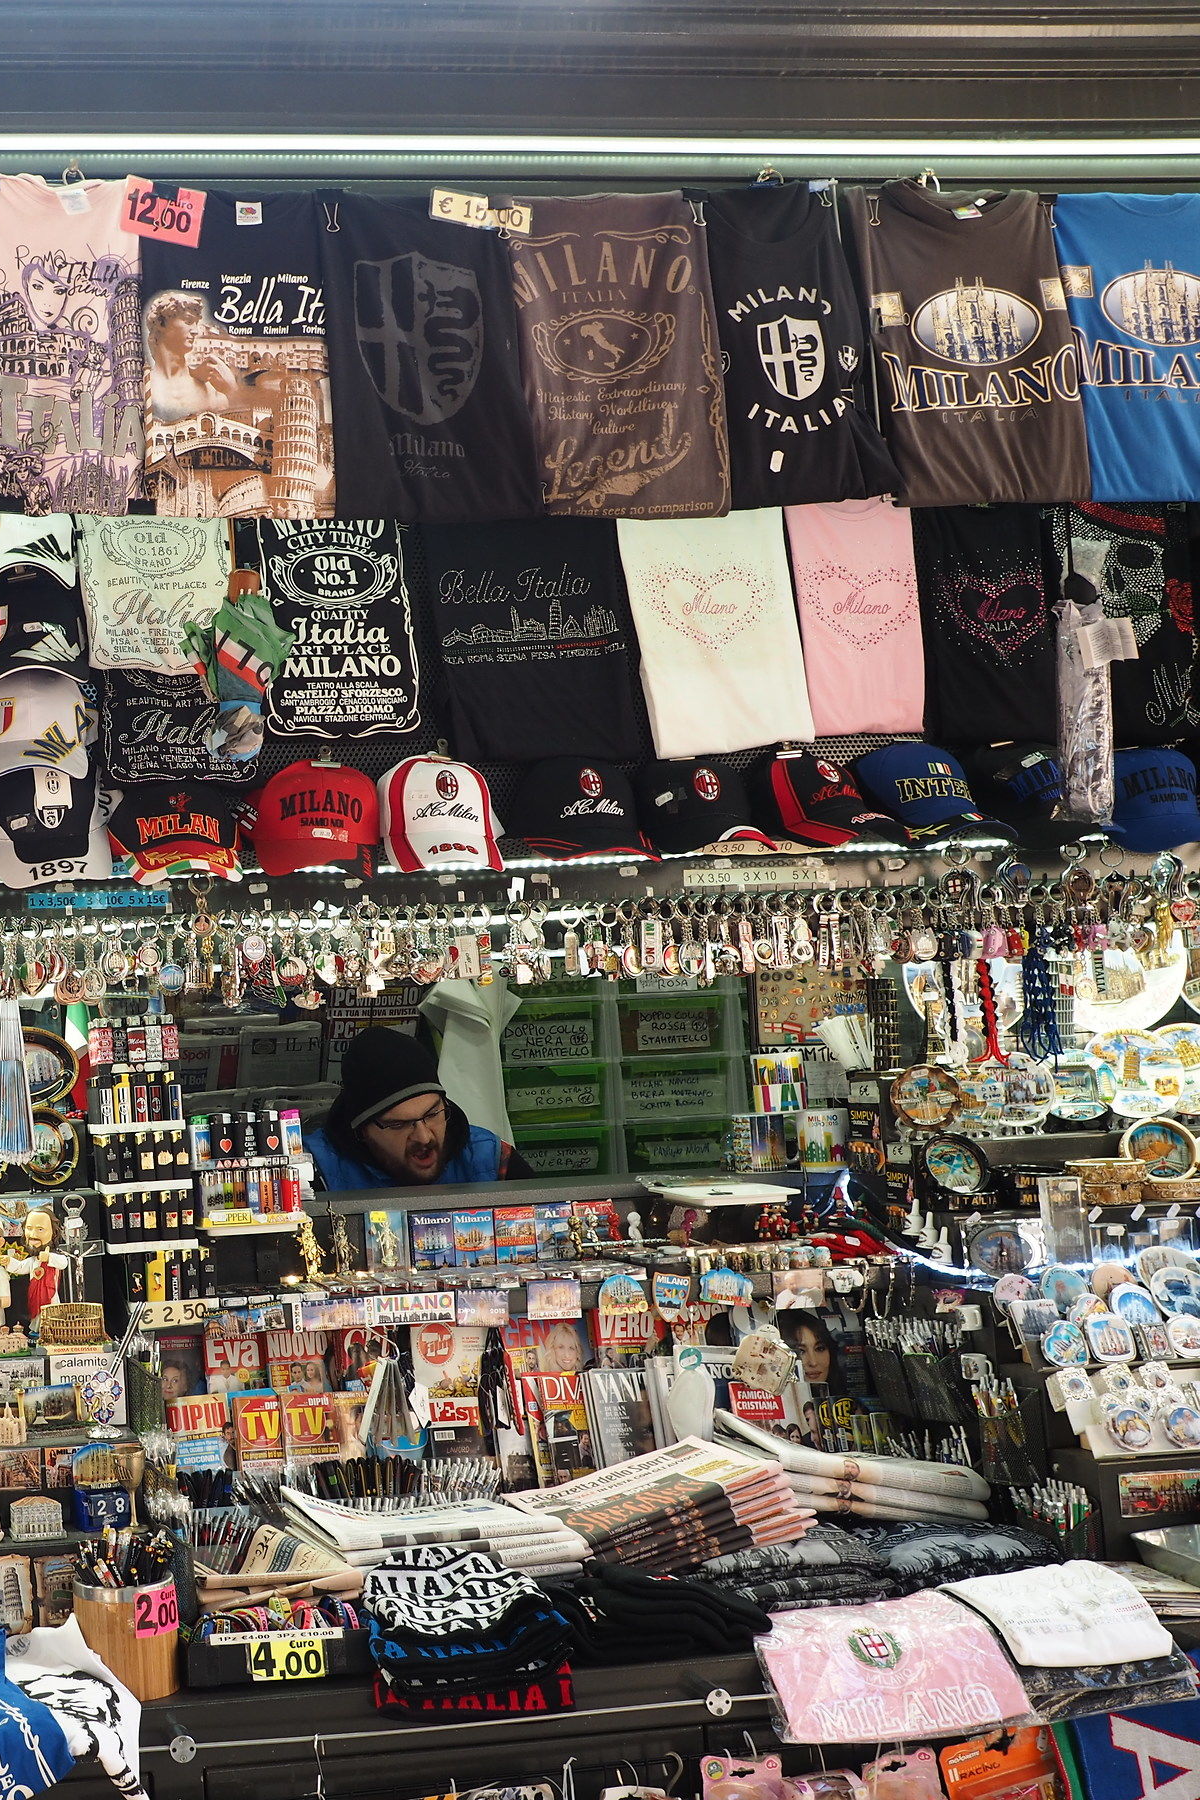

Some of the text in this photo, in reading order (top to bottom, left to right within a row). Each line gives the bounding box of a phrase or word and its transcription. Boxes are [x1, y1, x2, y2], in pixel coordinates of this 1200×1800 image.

[221, 274, 252, 285] Venezia
[278, 273, 308, 284] Milano
[513, 242, 692, 309] MILANO
[181, 279, 210, 291] Firenze
[216, 279, 284, 324] Bella
[228, 325, 252, 335] Roma
[263, 325, 289, 335] Rimini
[302, 325, 326, 335] Torino
[882, 345, 1081, 412] MILANO
[537, 380, 686, 406] Majestic Extraordinary
[549, 401, 678, 423] History Worldliness
[593, 422, 636, 437] Culture
[544, 406, 691, 504] Legend
[648, 500, 713, 514] comparison
[133, 532, 168, 545] Old
[286, 531, 372, 549] CITY TIME
[134, 556, 172, 568] BRAND
[313, 556, 351, 571] Old
[313, 571, 359, 585] No.1
[439, 563, 591, 604] Bella Italia
[154, 581, 207, 589] ART PLACES
[318, 588, 356, 597] BRAND
[682, 594, 738, 617] Milano
[833, 591, 893, 617] Milano
[311, 610, 369, 620] QUALITY
[106, 628, 138, 636] MILANO
[291, 617, 389, 644] Italia
[142, 638, 175, 647] VENEZIA
[113, 645, 140, 653] SIENA
[332, 644, 391, 655] PLACE
[496, 648, 601, 663] SIENA PISA FIRENZE
[283, 657, 401, 678] MILANO
[156, 676, 193, 685] BRAND
[307, 681, 334, 689] TEATRO
[336, 681, 354, 689] ALLA
[283, 688, 403, 699] CASTELLO SFORZESCO
[126, 698, 191, 707] BEAUTIFUL ART
[280, 696, 408, 706] SANT'AMBROGIO CENACOLO VINCIANO
[296, 704, 393, 715] PIAZZA DUOMO
[294, 713, 397, 722] NAVIGLI STAZIONE CENTRALE
[122, 747, 161, 755] MILANO
[128, 754, 197, 763] PISA VENEZIA
[131, 762, 238, 771] SIENA GARDA
[280, 791, 363, 824] MILANO
[300, 818, 323, 827] SIAMO
[138, 814, 219, 844] MILAN
[28, 860, 88, 881] 1897
[335, 991, 352, 1006] PC
[505, 1025, 585, 1036] DOPPIO COLLO
[651, 1021, 688, 1031] ROSSA
[526, 1036, 562, 1046] NERA
[641, 1033, 708, 1044] STAMPATELLO
[512, 1046, 589, 1059] STAMPATELLO
[536, 1095, 573, 1106] ROSA
[808, 1114, 838, 1122] MILANO
[886, 1171, 908, 1184] SIMPLY
[414, 1216, 450, 1225] Milano
[455, 1215, 490, 1223] Milano
[657, 1276, 689, 1286] MILANO
[376, 1294, 453, 1313] MILANO
[141, 1304, 206, 1325] € 2,50
[600, 1314, 654, 1339] VERO
[266, 1331, 328, 1358] NUOVO
[205, 1338, 260, 1367] Eva
[60, 1357, 107, 1367] calamite
[308, 1395, 329, 1406] DIPIÙ
[736, 1400, 779, 1411] CRISTIANA
[166, 1398, 226, 1432] DIPIÙ
[286, 1407, 323, 1435] TV
[241, 1410, 279, 1440] TV
[184, 1456, 220, 1465] GIOCONDA
[630, 1455, 672, 1474] Sport
[98, 1498, 124, 1515] 2 8
[135, 1591, 177, 1636] 2,00
[252, 1642, 322, 1677] 4,00
[813, 1682, 1001, 1738] MILANO
